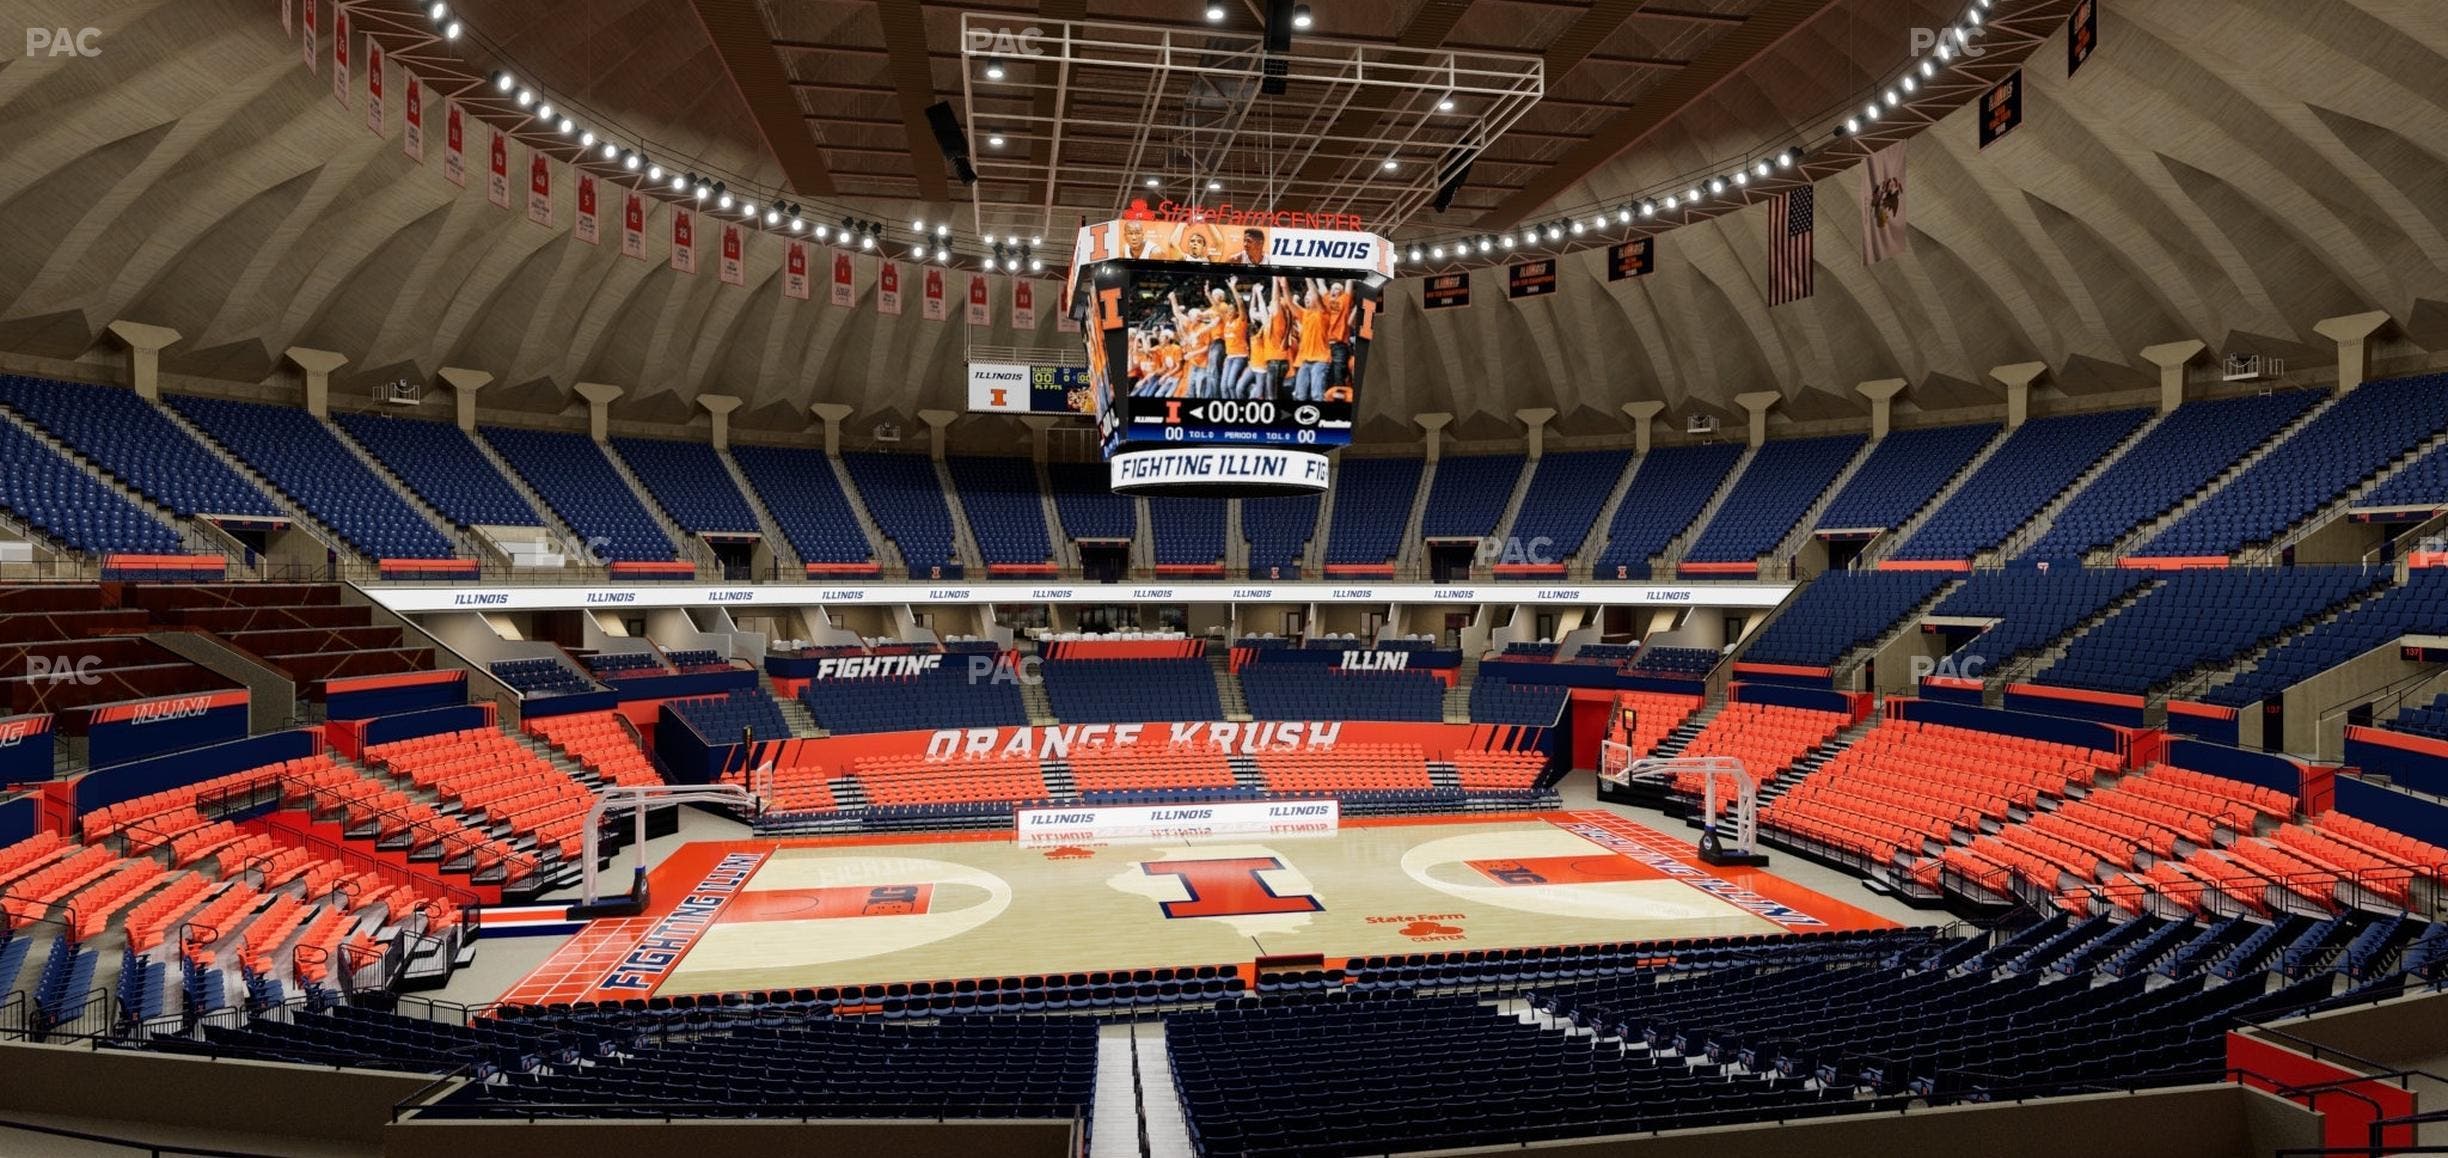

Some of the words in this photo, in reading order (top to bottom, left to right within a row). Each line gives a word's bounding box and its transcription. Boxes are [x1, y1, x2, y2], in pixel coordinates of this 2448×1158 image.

[1272, 237, 1370, 261] ILLINOIS
[975, 371, 1023, 381] ILLINOIS
[1034, 373, 1052, 383] 00
[1208, 401, 1275, 423] 00:00
[1165, 427, 1183, 441] 00
[1297, 430, 1316, 443] 00
[1121, 455, 1213, 479] FIGHTING
[1218, 456, 1287, 477] ILLINI
[587, 592, 636, 602] ILLINOIS
[709, 591, 754, 600] ILLINOIS
[822, 590, 865, 599] ILLINOIS
[930, 590, 971, 599] ILLINOIS
[1033, 590, 1073, 598] ILLINOIS
[1134, 589, 1173, 597] ILLINOIS
[1233, 589, 1273, 597] ILLINOIS
[1333, 590, 1373, 598] ILLINOIS
[1434, 590, 1475, 598] ILLINOIS
[1538, 590, 1580, 599] ILLINOIS
[1647, 591, 1691, 600] ILLINOIS
[455, 593, 509, 604] ILLINOIS
[1341, 650, 1408, 671] ILLINI
[131, 696, 211, 725] ILLINI
[1151, 808, 1212, 820] ILLINOIS
[1270, 804, 1329, 816] ILLINOIS
[1031, 812, 1095, 825] ILLINOIS
[598, 895, 726, 990] FIGHTING
[696, 852, 766, 893] ILLINI
